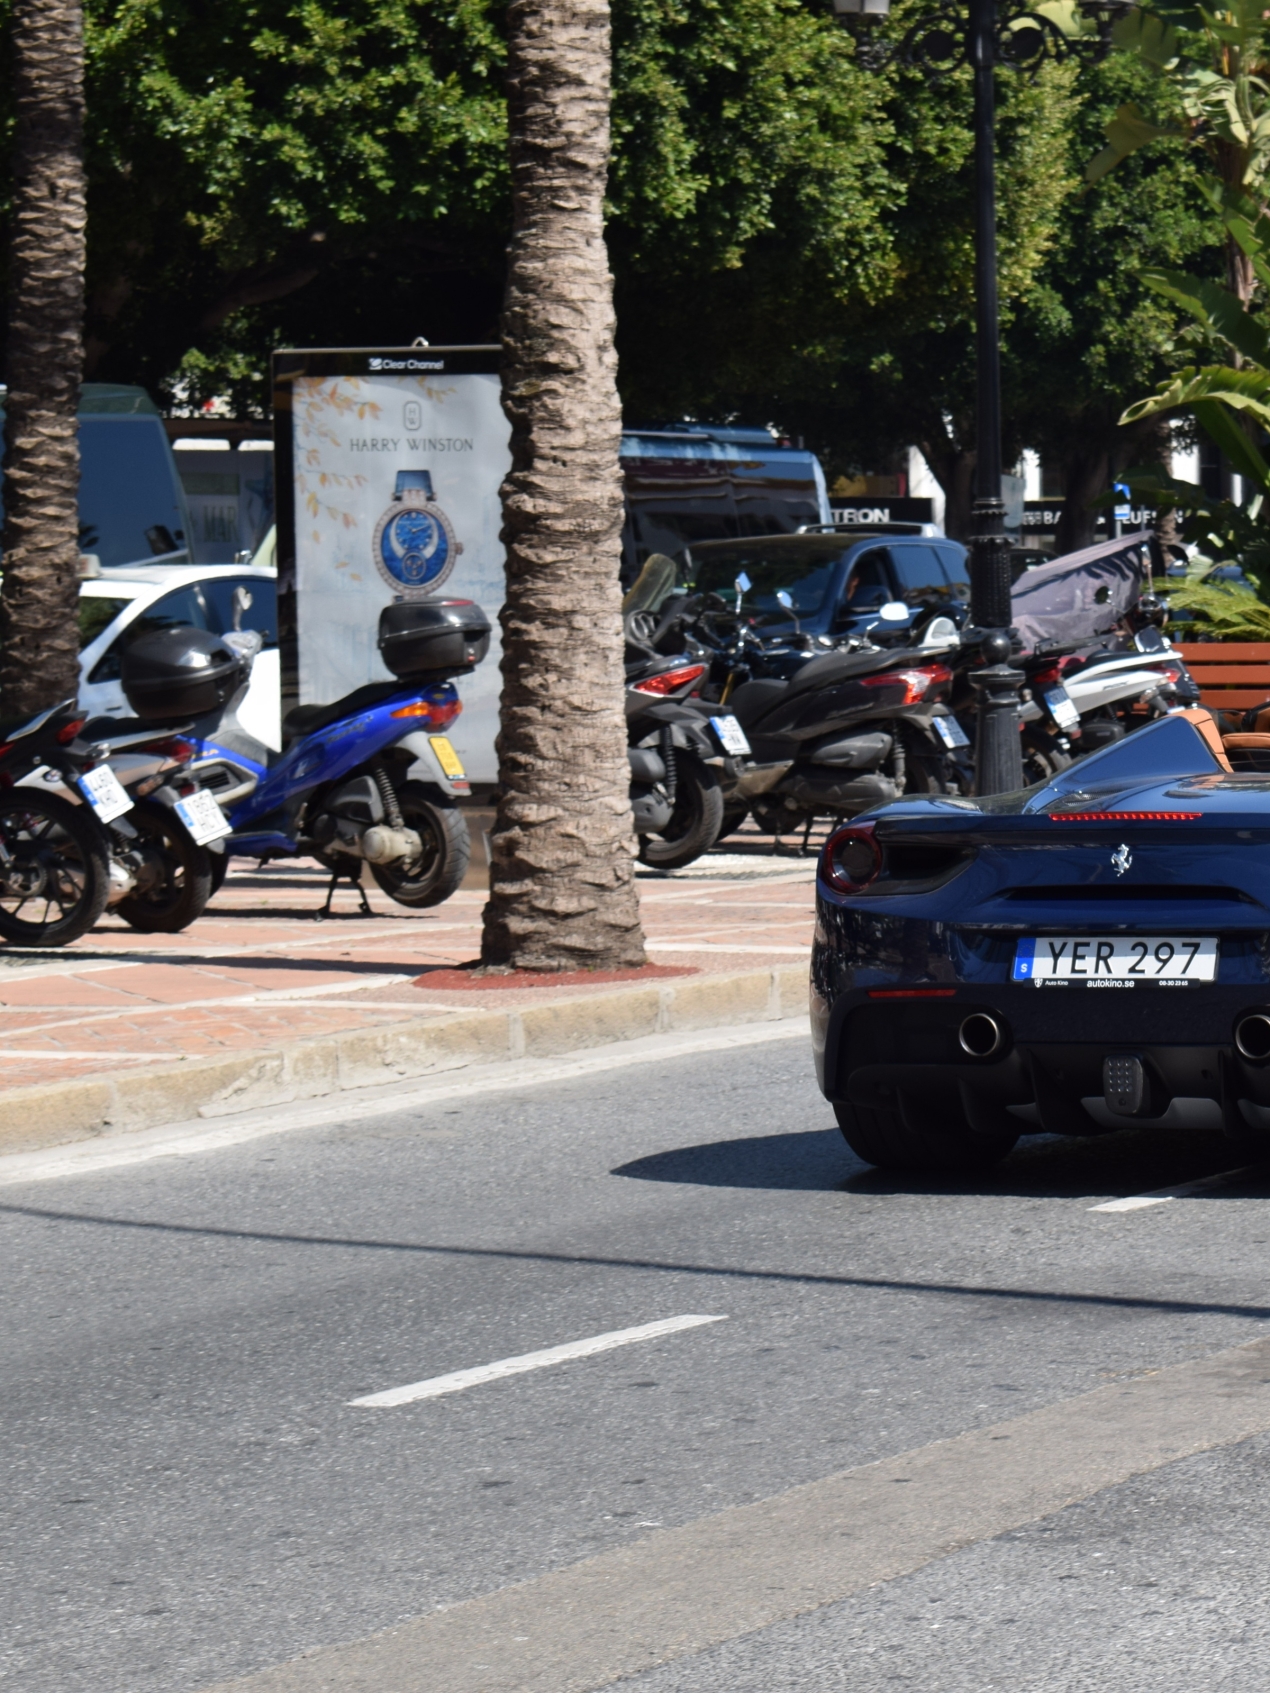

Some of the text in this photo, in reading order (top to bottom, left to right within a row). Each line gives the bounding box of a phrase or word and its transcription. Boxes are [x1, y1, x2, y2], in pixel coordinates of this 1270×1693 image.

[383, 359, 444, 370] Clear Channel
[350, 438, 473, 452] HARRY WINSTON
[1020, 941, 1201, 975] S YER 297
[1086, 979, 1135, 988] autokino.se
